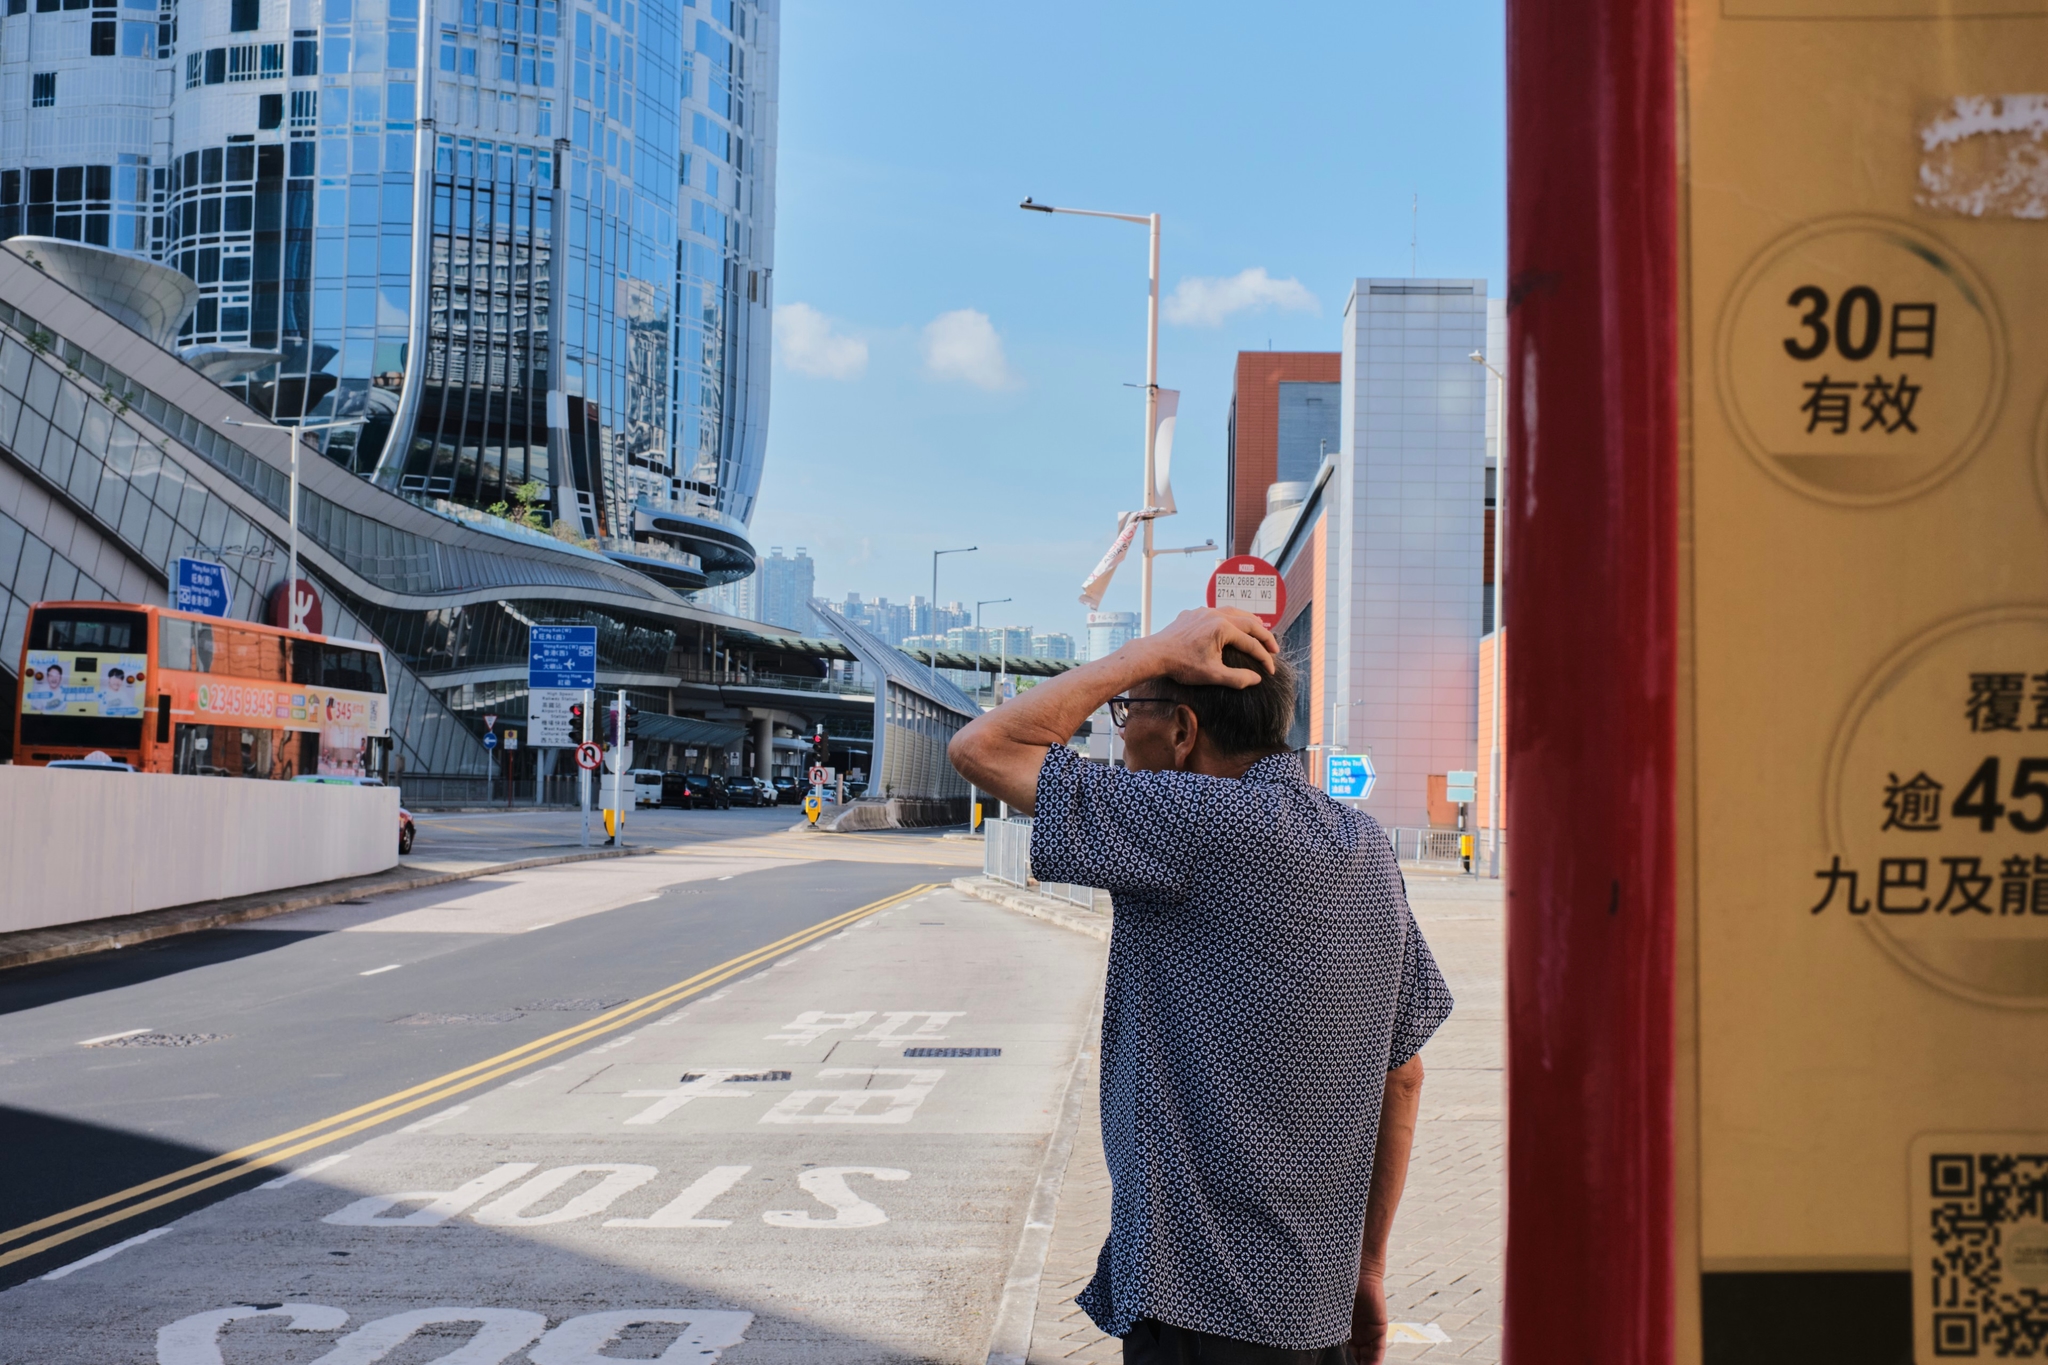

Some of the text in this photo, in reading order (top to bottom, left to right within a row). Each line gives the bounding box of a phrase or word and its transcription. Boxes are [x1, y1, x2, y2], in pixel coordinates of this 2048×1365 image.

[1783, 285, 1937, 361] 30日
[1800, 374, 1923, 435] 有效
[1217, 589, 1272, 599] 271A W2 W3
[1218, 576, 1275, 587] 260X 268B 269B
[210, 685, 274, 717] 2345 9345
[335, 701, 352, 720] 345
[1811, 854, 2048, 916] 九巴及龍
[622, 1068, 946, 1125] 巴士
[322, 1163, 910, 1229] STOP
[155, 1303, 755, 1365] BUS
